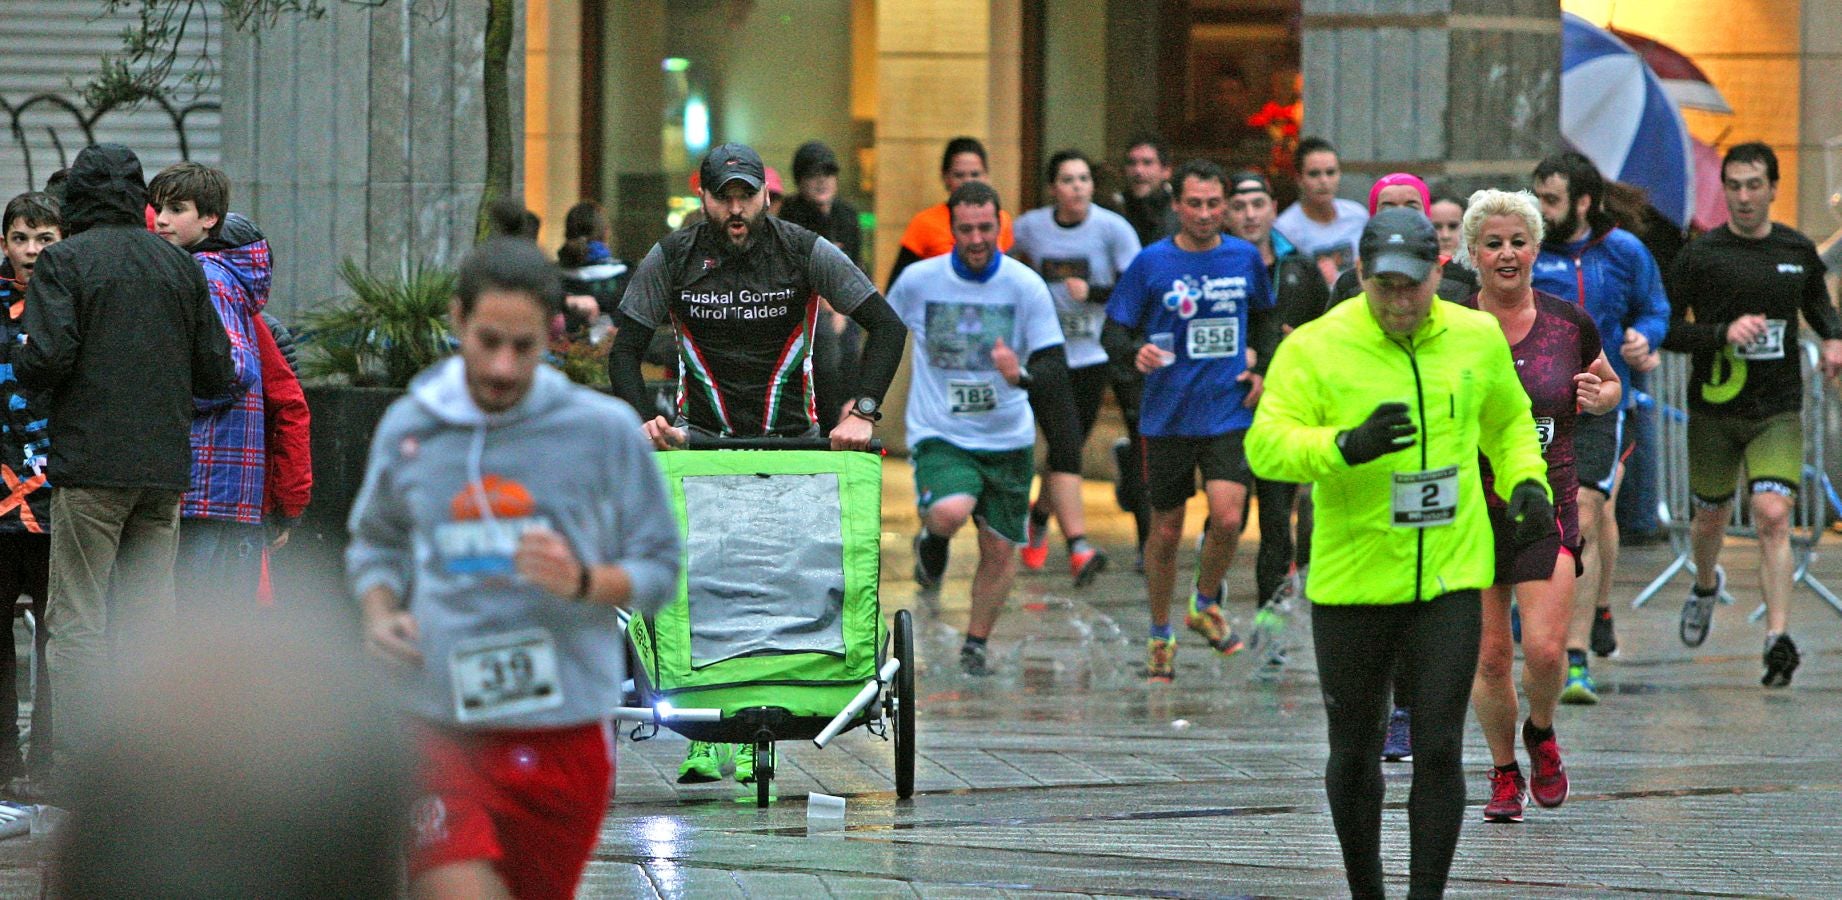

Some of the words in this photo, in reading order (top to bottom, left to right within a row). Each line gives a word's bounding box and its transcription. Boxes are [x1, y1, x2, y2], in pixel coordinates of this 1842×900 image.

[681, 290, 733, 304] Euskal
[690, 305, 727, 320] Kirol
[731, 305, 788, 320] Taldea
[1194, 327, 1234, 345] 658
[955, 388, 993, 404] 182
[1421, 482, 1440, 508] 2
